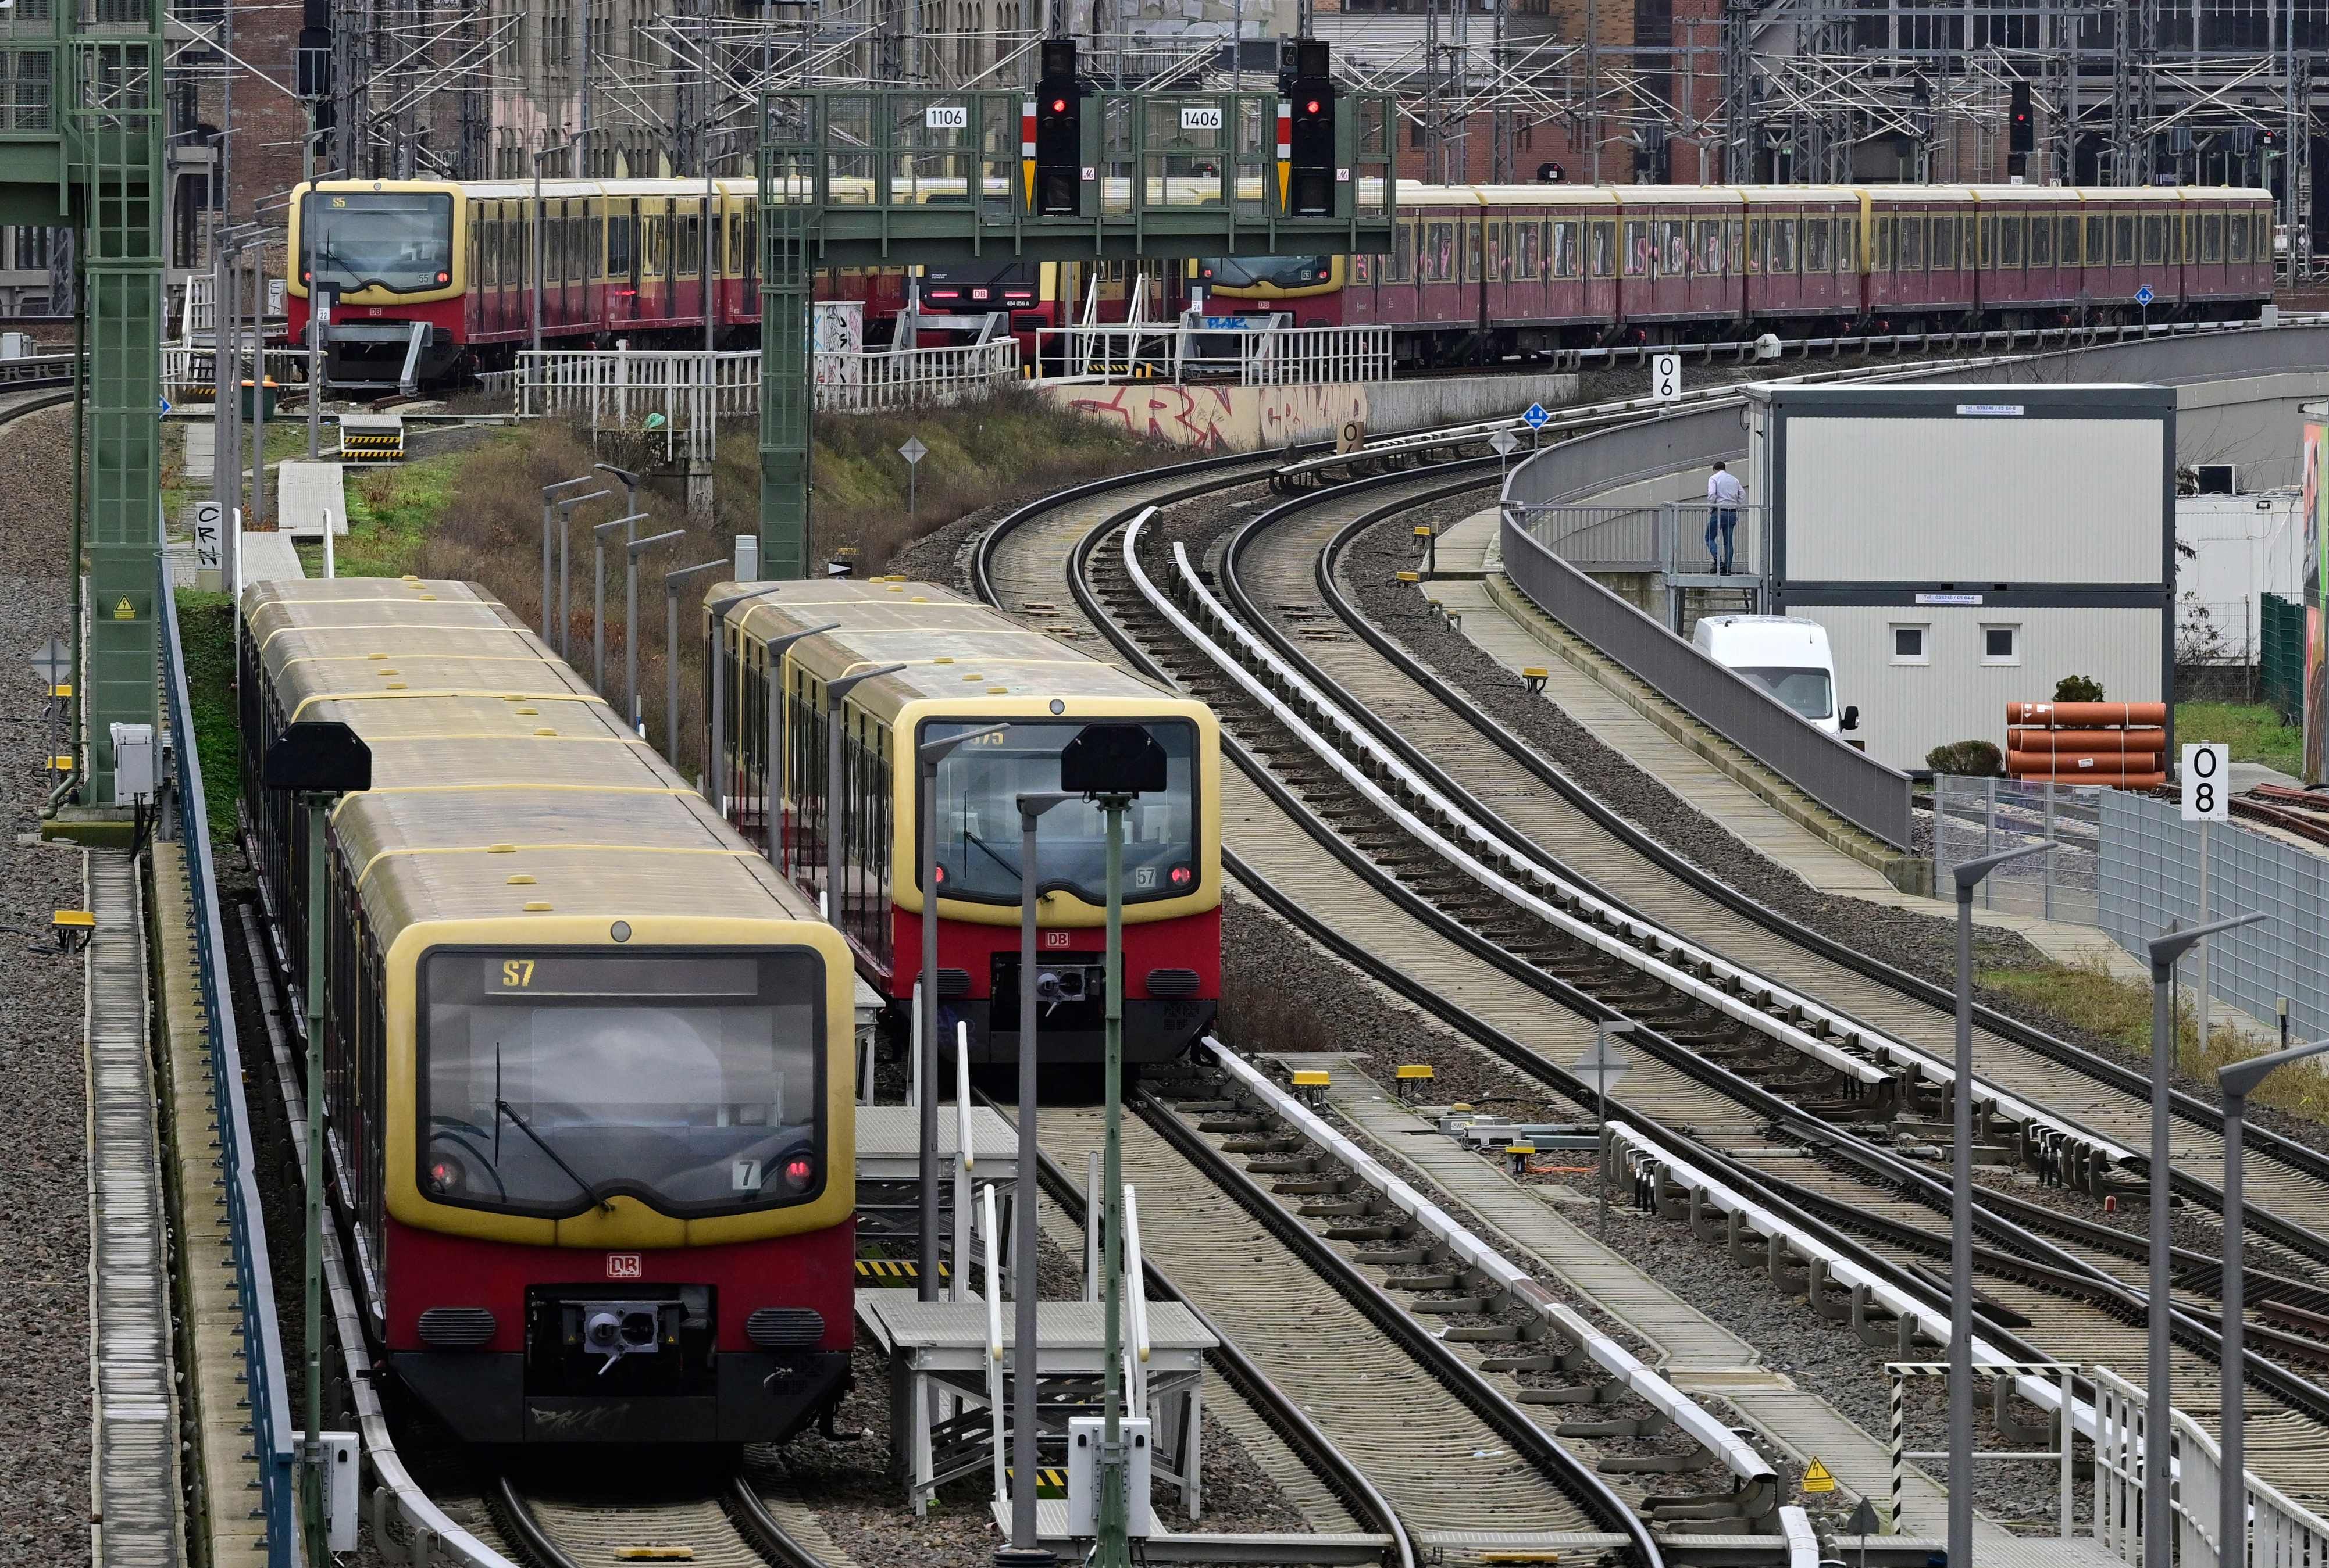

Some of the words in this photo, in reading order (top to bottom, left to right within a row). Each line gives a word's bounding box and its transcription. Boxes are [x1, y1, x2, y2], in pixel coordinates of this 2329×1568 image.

[932, 110, 962, 124] 1106
[1184, 112, 1218, 126] 1406
[333, 197, 345, 208] S5
[419, 274, 429, 283] 55
[973, 290, 986, 298] DB
[1137, 869, 1155, 884] 57
[1048, 933, 1068, 945] DB
[503, 960, 534, 987] S7
[739, 1161, 754, 1186] 7
